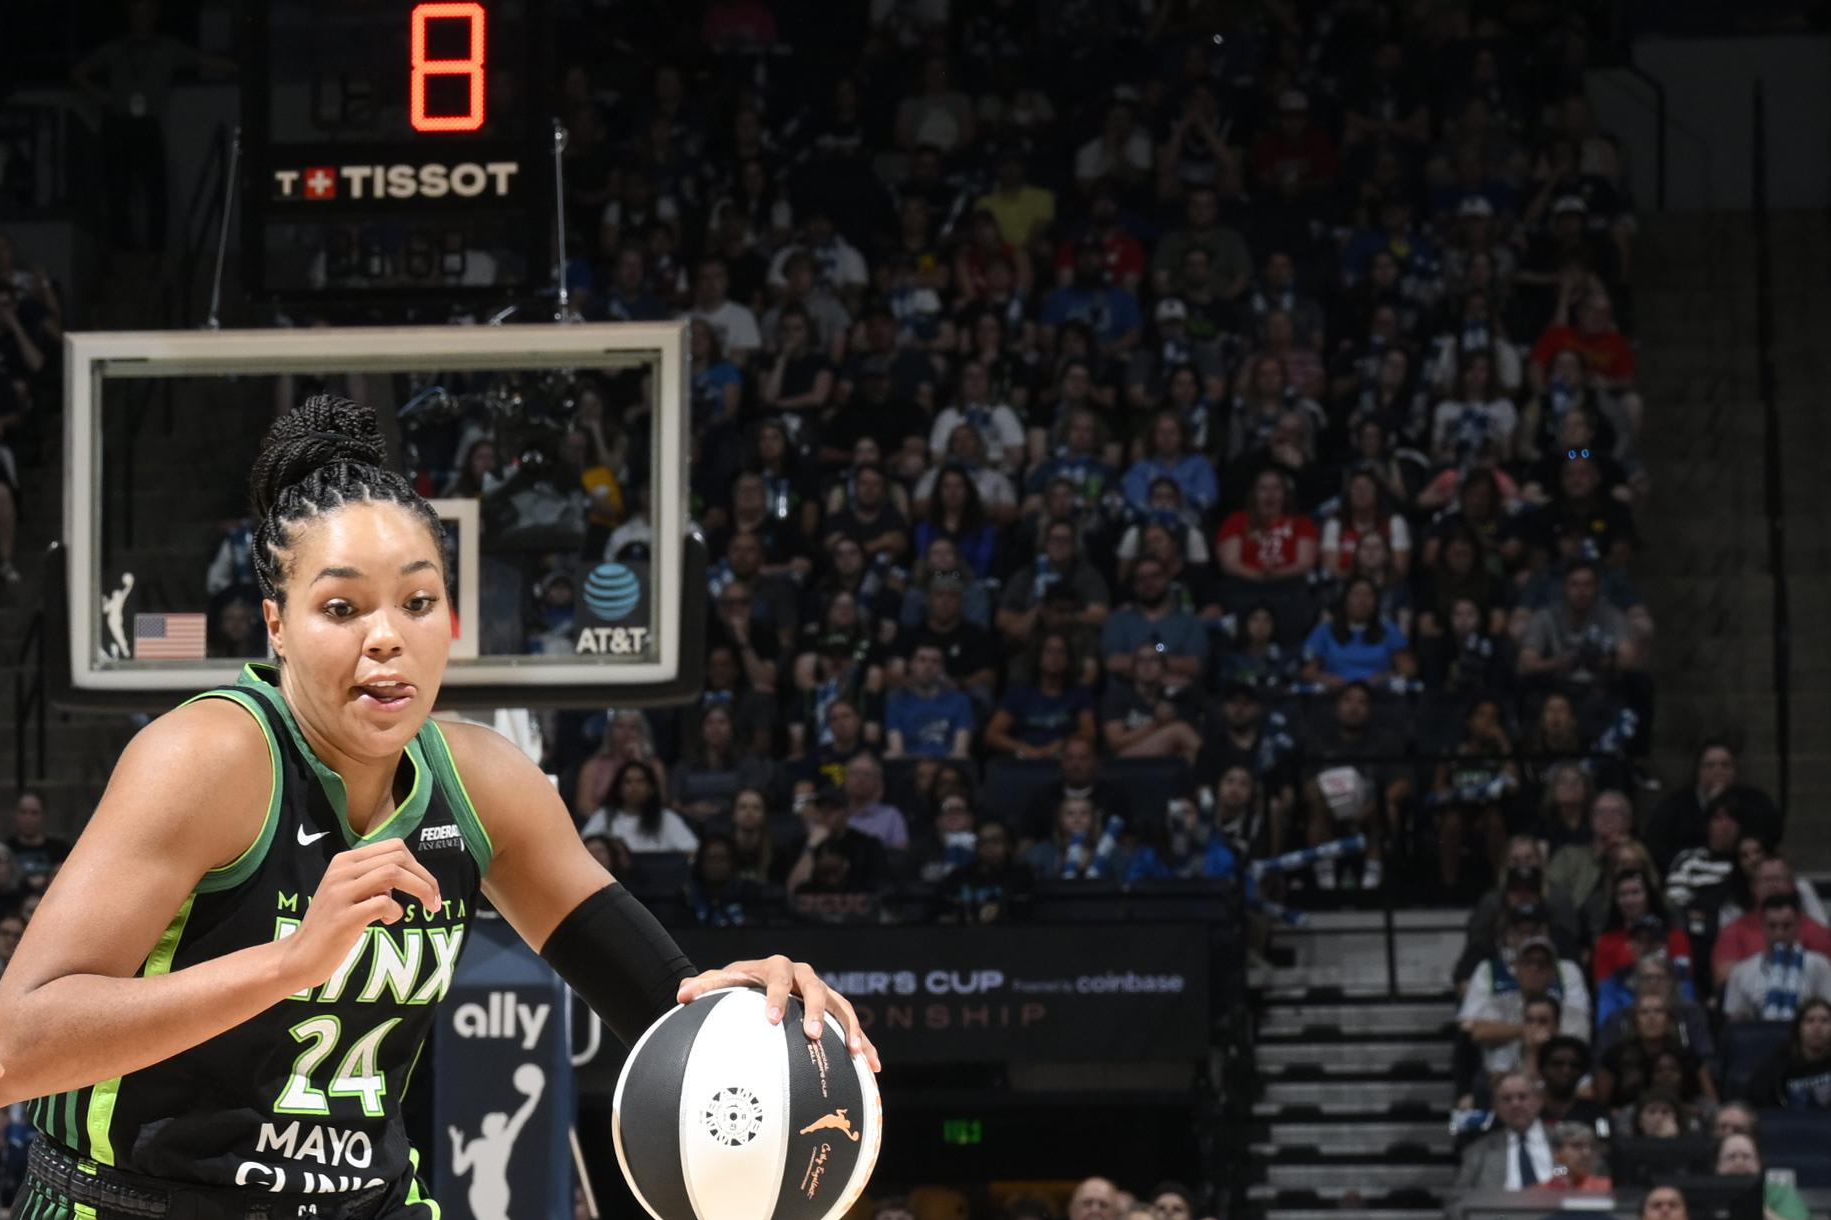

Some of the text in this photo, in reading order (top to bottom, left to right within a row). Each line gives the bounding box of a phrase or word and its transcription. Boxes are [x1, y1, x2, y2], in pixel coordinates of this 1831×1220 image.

[410, 2, 486, 132] 8
[341, 162, 519, 199] TISSOT
[576, 627, 648, 654] AT&T
[925, 970, 1005, 995] CUP
[1076, 970, 1186, 994] coinbase
[453, 991, 550, 1050] ally
[273, 1014, 403, 1117] 24
[255, 1120, 373, 1169] MAYO
